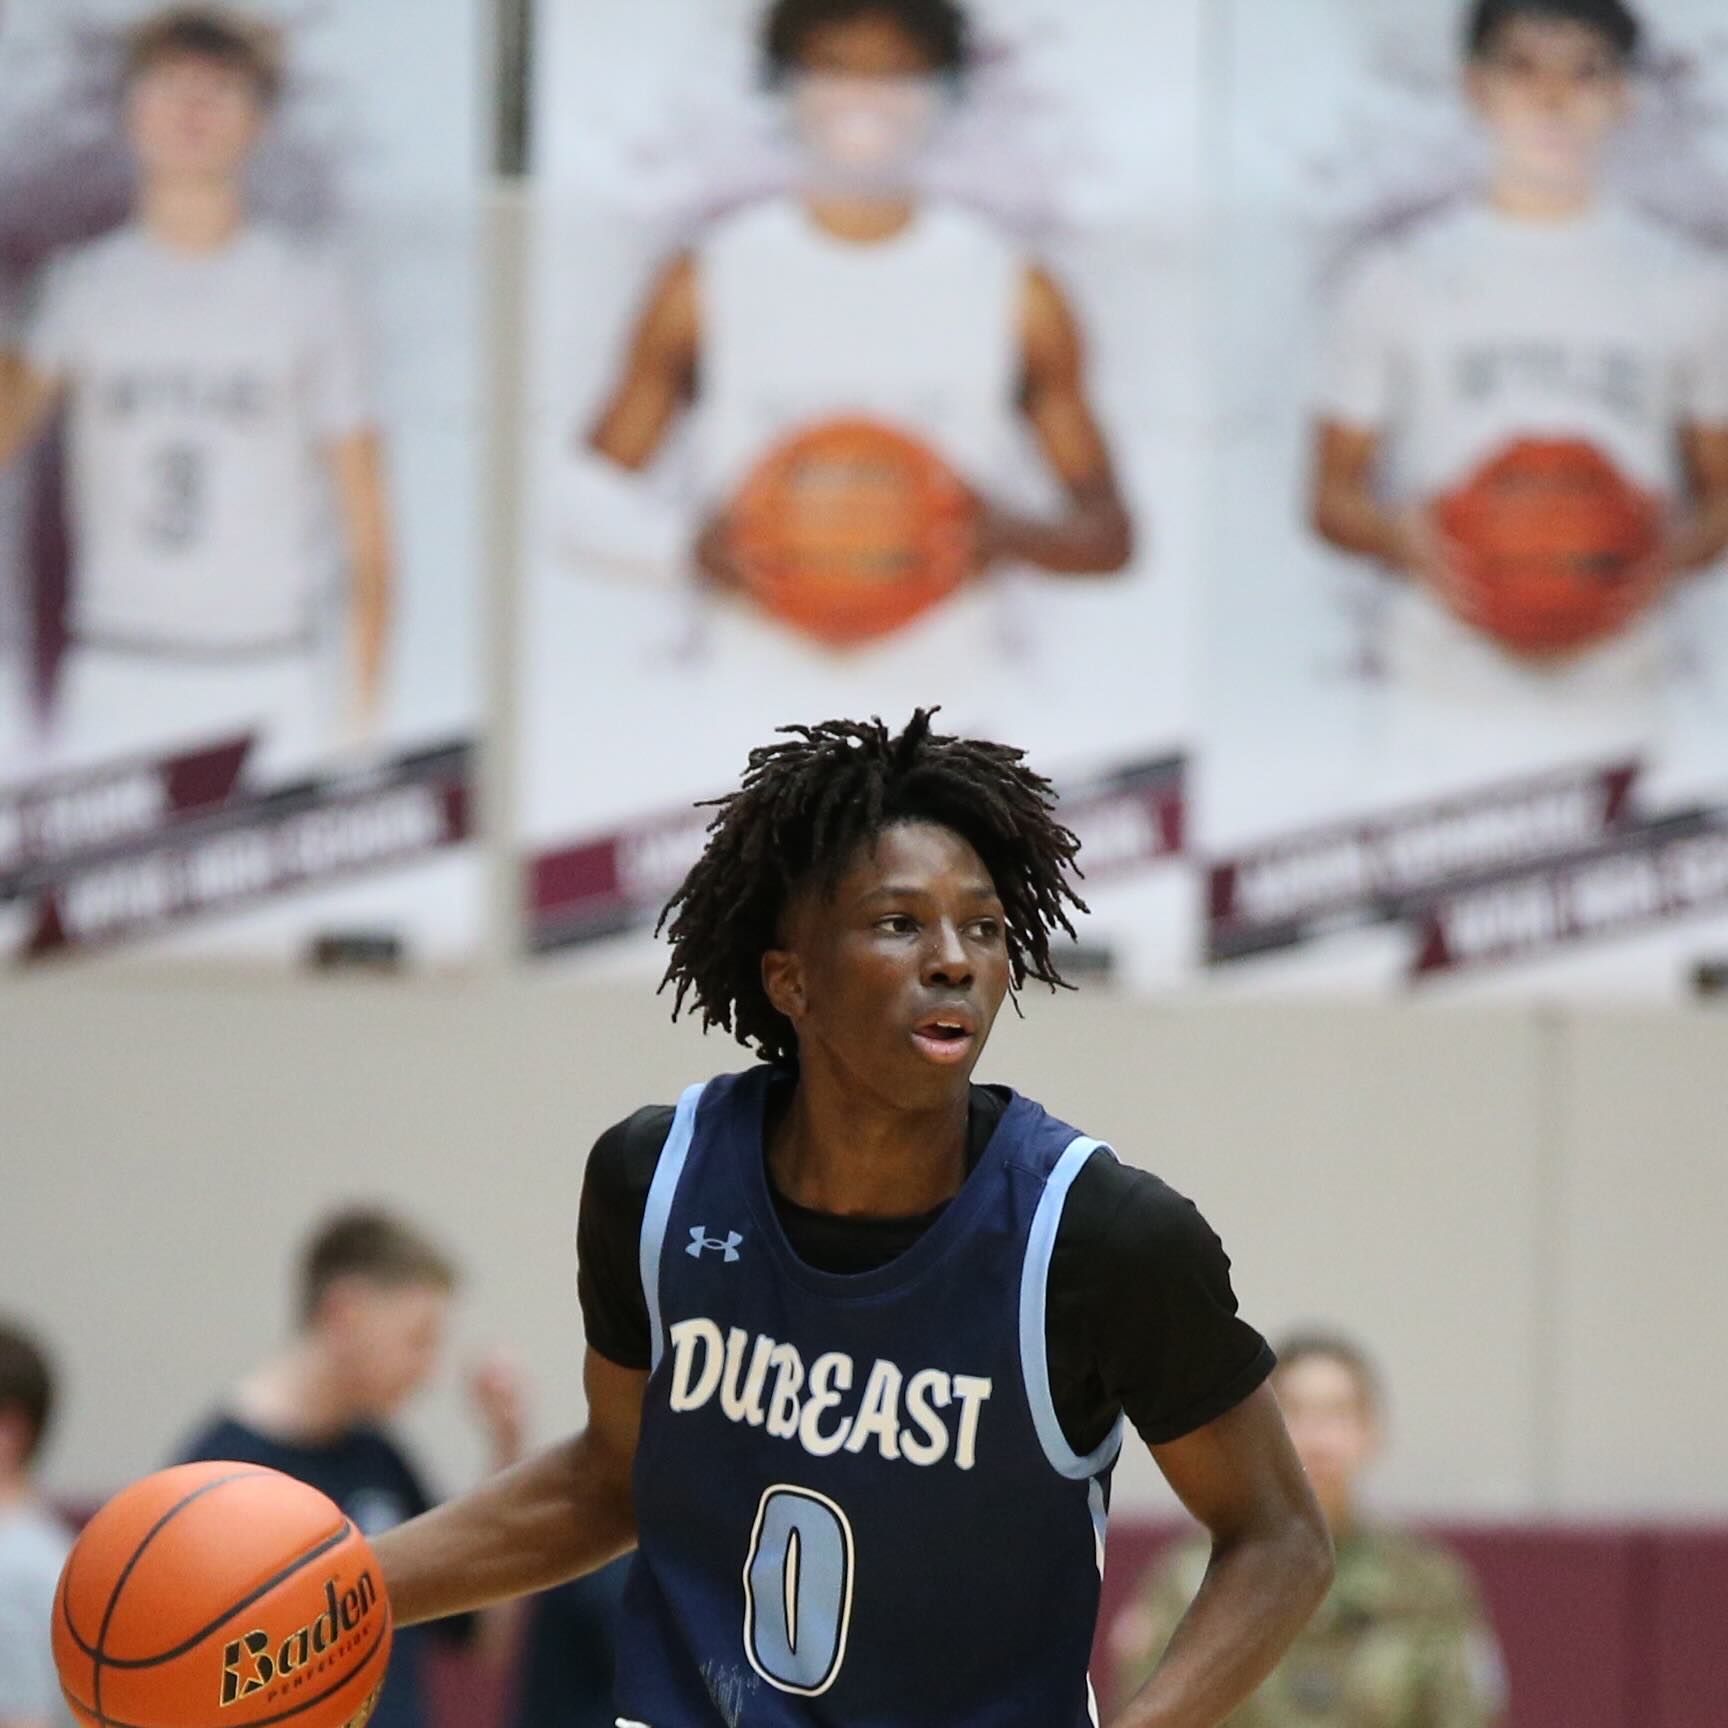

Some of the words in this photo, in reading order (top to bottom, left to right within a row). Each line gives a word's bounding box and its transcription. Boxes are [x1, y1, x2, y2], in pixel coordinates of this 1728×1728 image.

[669, 1317, 992, 1470] DUBEAST
[219, 1570, 377, 1708] Baden
[742, 1483, 855, 1697] 0
